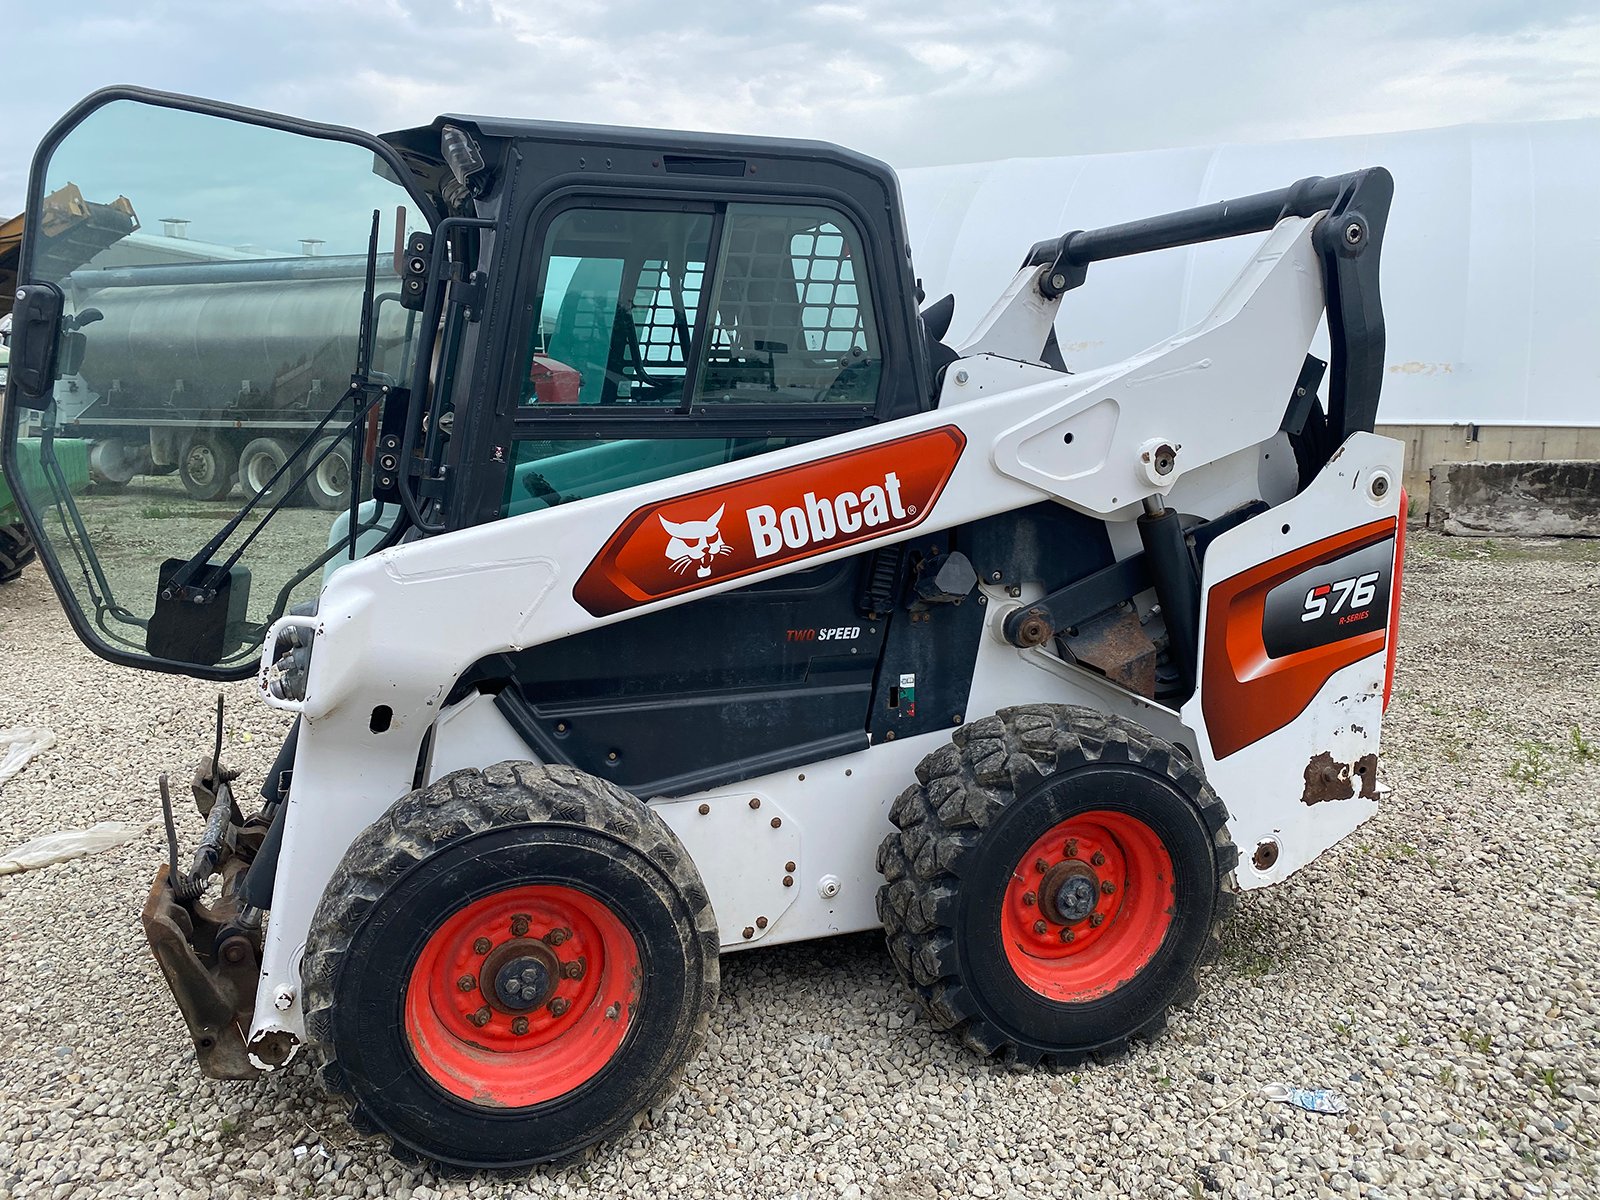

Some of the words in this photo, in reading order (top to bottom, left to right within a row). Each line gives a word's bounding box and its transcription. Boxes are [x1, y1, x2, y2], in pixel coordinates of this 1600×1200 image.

[1302, 572, 1379, 622] S76
[1339, 611, 1369, 625] R-SERIES
[787, 629, 816, 641] TWO
[818, 627, 860, 641] SPEED
